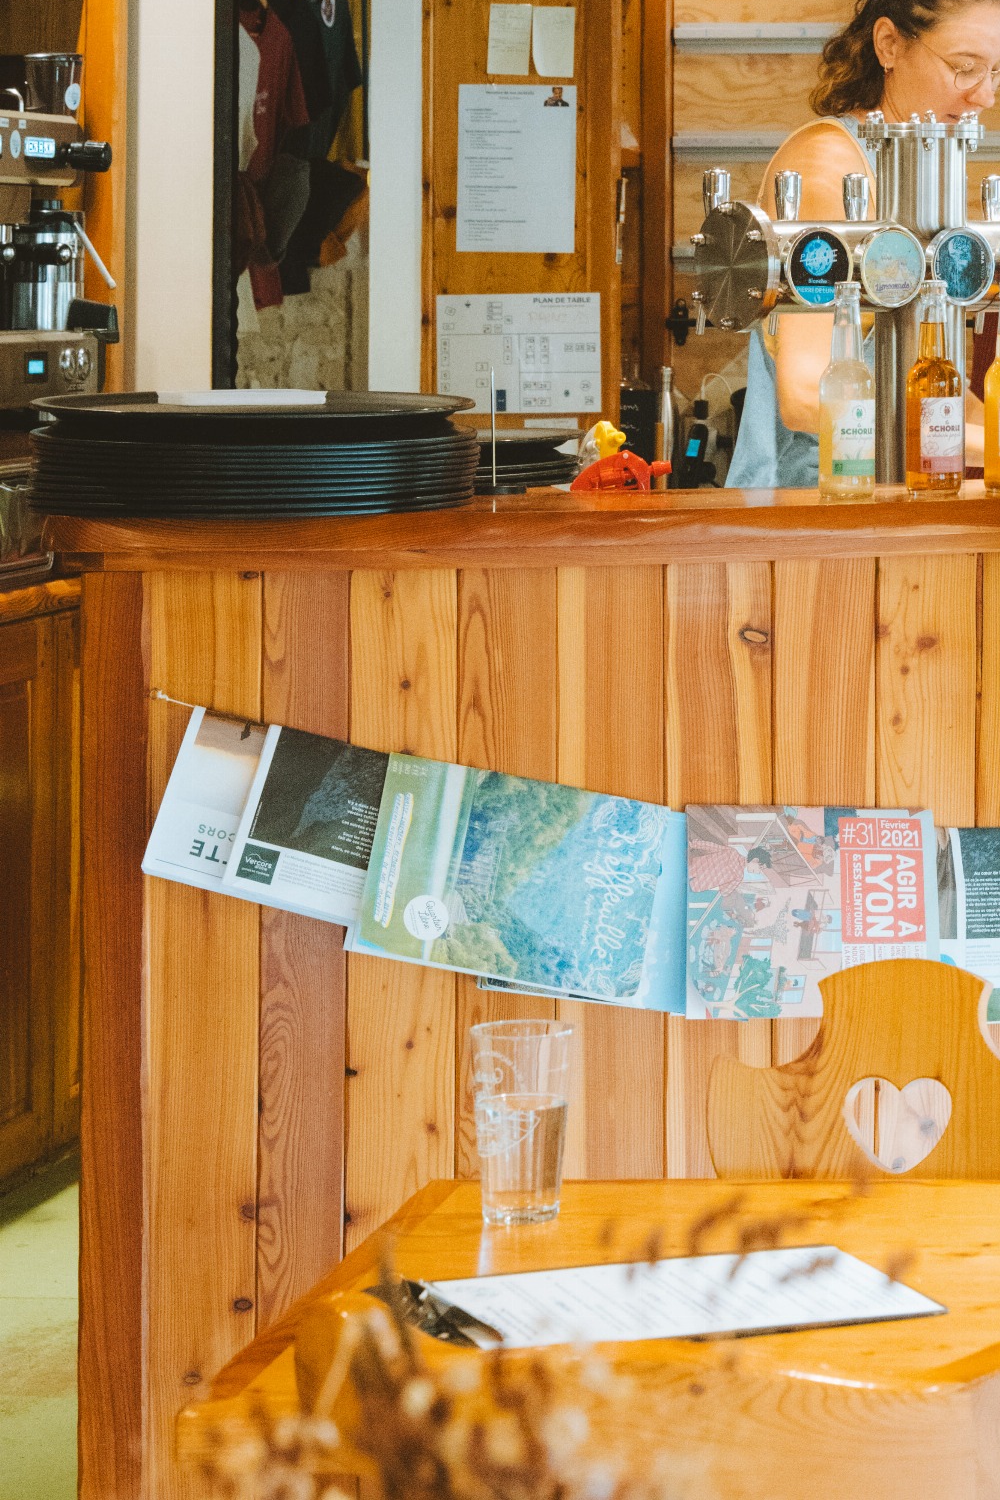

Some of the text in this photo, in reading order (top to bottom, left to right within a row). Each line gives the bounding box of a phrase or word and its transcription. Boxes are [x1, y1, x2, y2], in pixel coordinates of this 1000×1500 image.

[842, 822, 874, 845] #31
[880, 820, 910, 829] Février
[881, 830, 919, 847] 2021
[896, 854, 917, 909] AGIR
[852, 853, 863, 937] & SES ALENTOURS
[864, 853, 894, 938] LYON
[417, 911, 430, 930] Libre
[427, 900, 443, 932] Quartier
[897, 920, 923, 937] À
